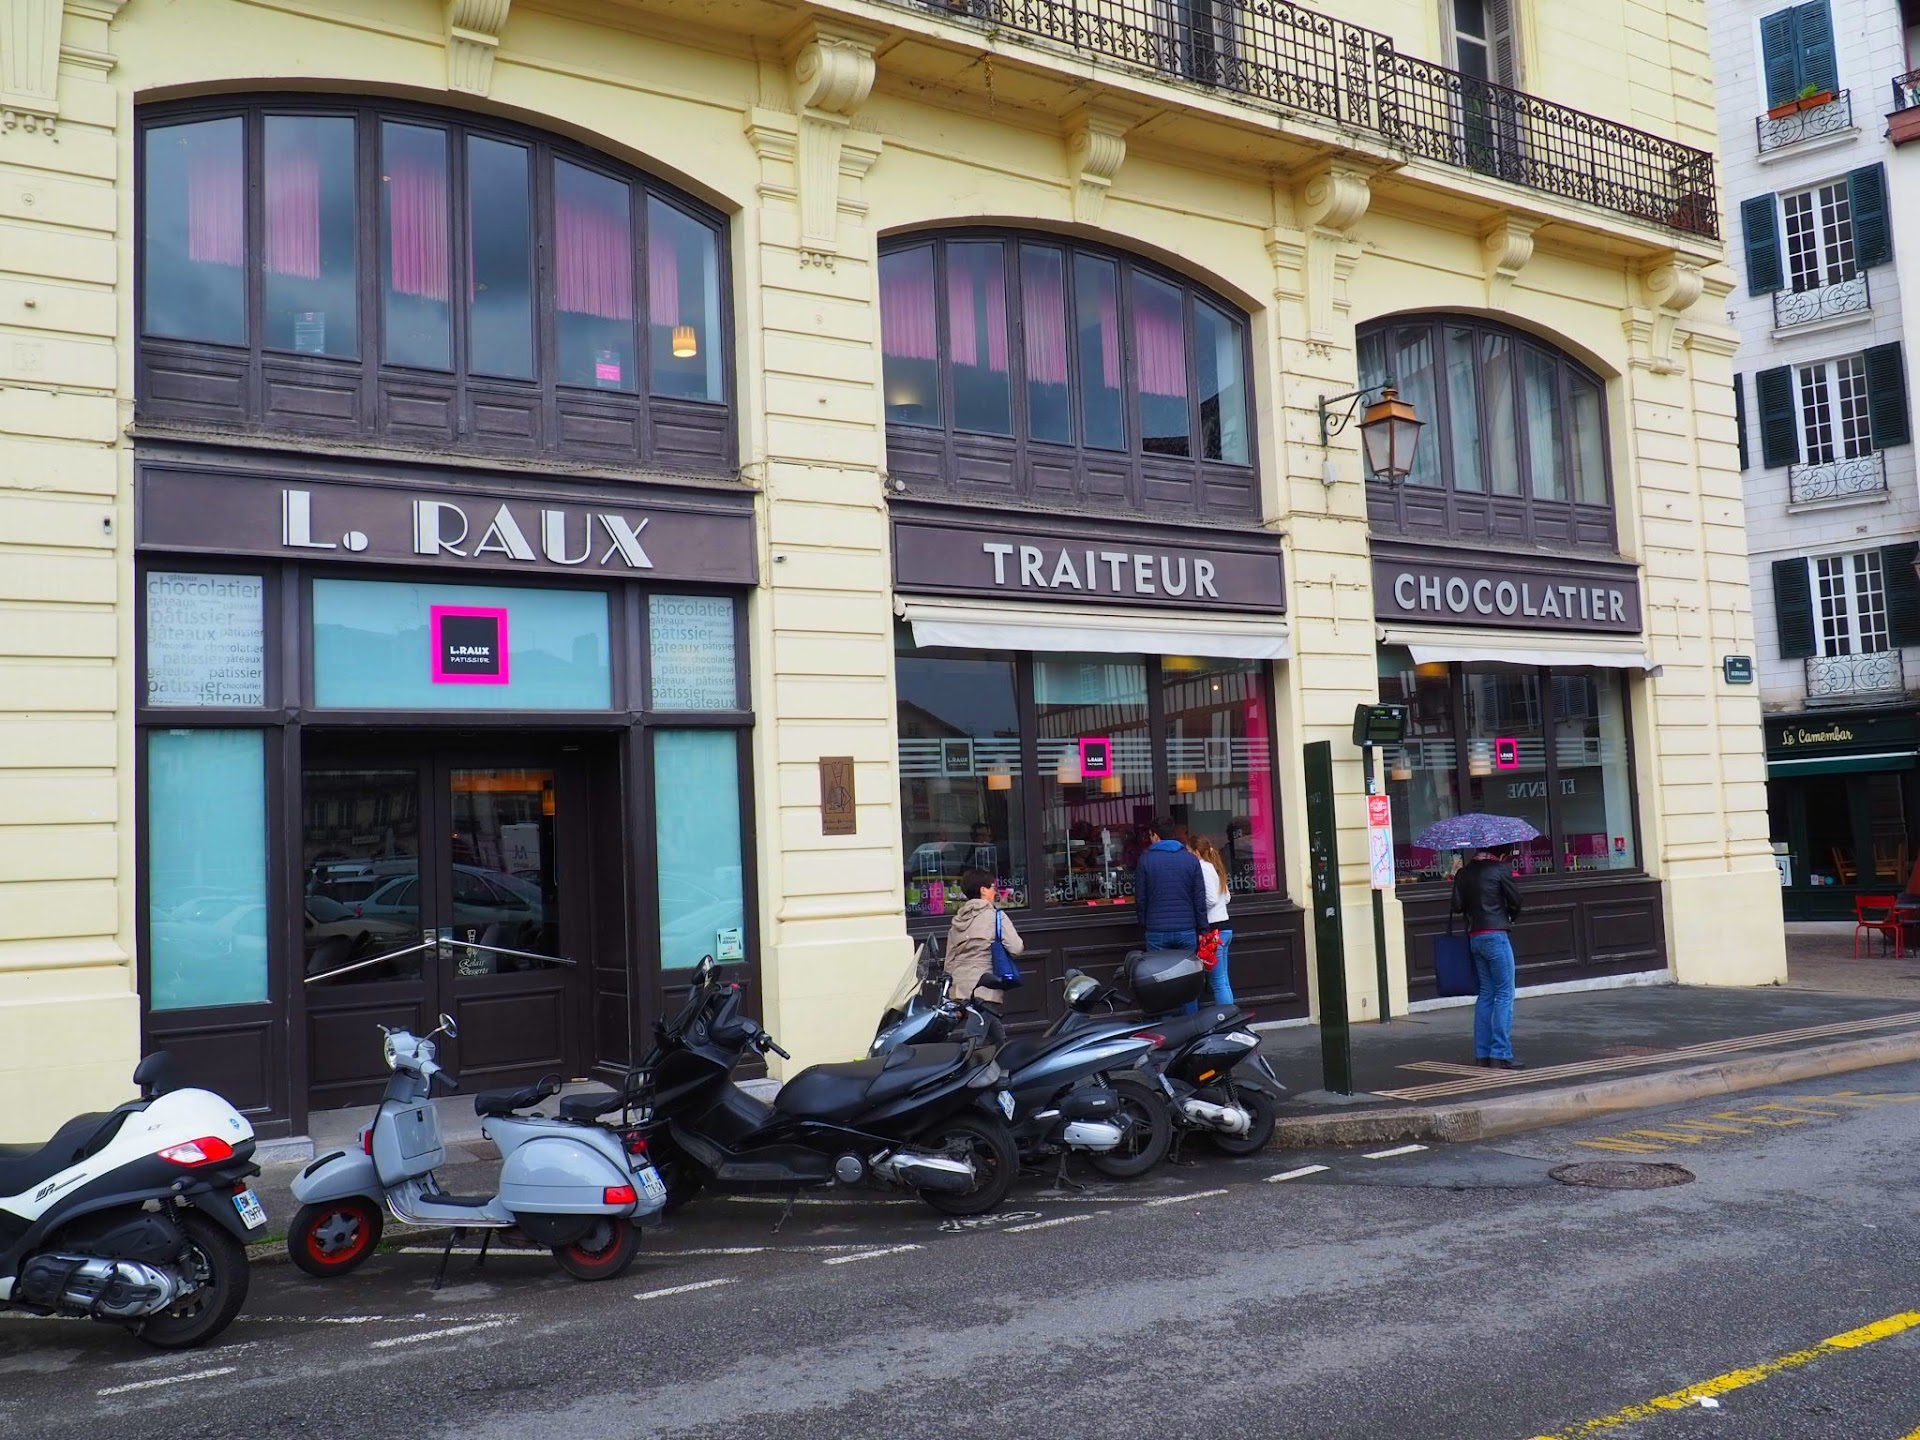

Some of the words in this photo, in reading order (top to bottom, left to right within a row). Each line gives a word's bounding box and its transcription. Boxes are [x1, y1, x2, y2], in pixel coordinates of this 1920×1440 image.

[282, 489, 368, 552] L.
[412, 500, 654, 569] RAUX
[983, 542, 1219, 598] TRAITEUR
[148, 577, 260, 598] chocolatier
[650, 599, 732, 617] chocolatier
[1394, 573, 1626, 623] CHOCOLATIER
[151, 607, 235, 627] pâtissier
[651, 625, 713, 642] pâtissier
[450, 645, 490, 655] L.RAUX
[1782, 730, 1795, 745] Le
[1798, 726, 1853, 743] Camembar
